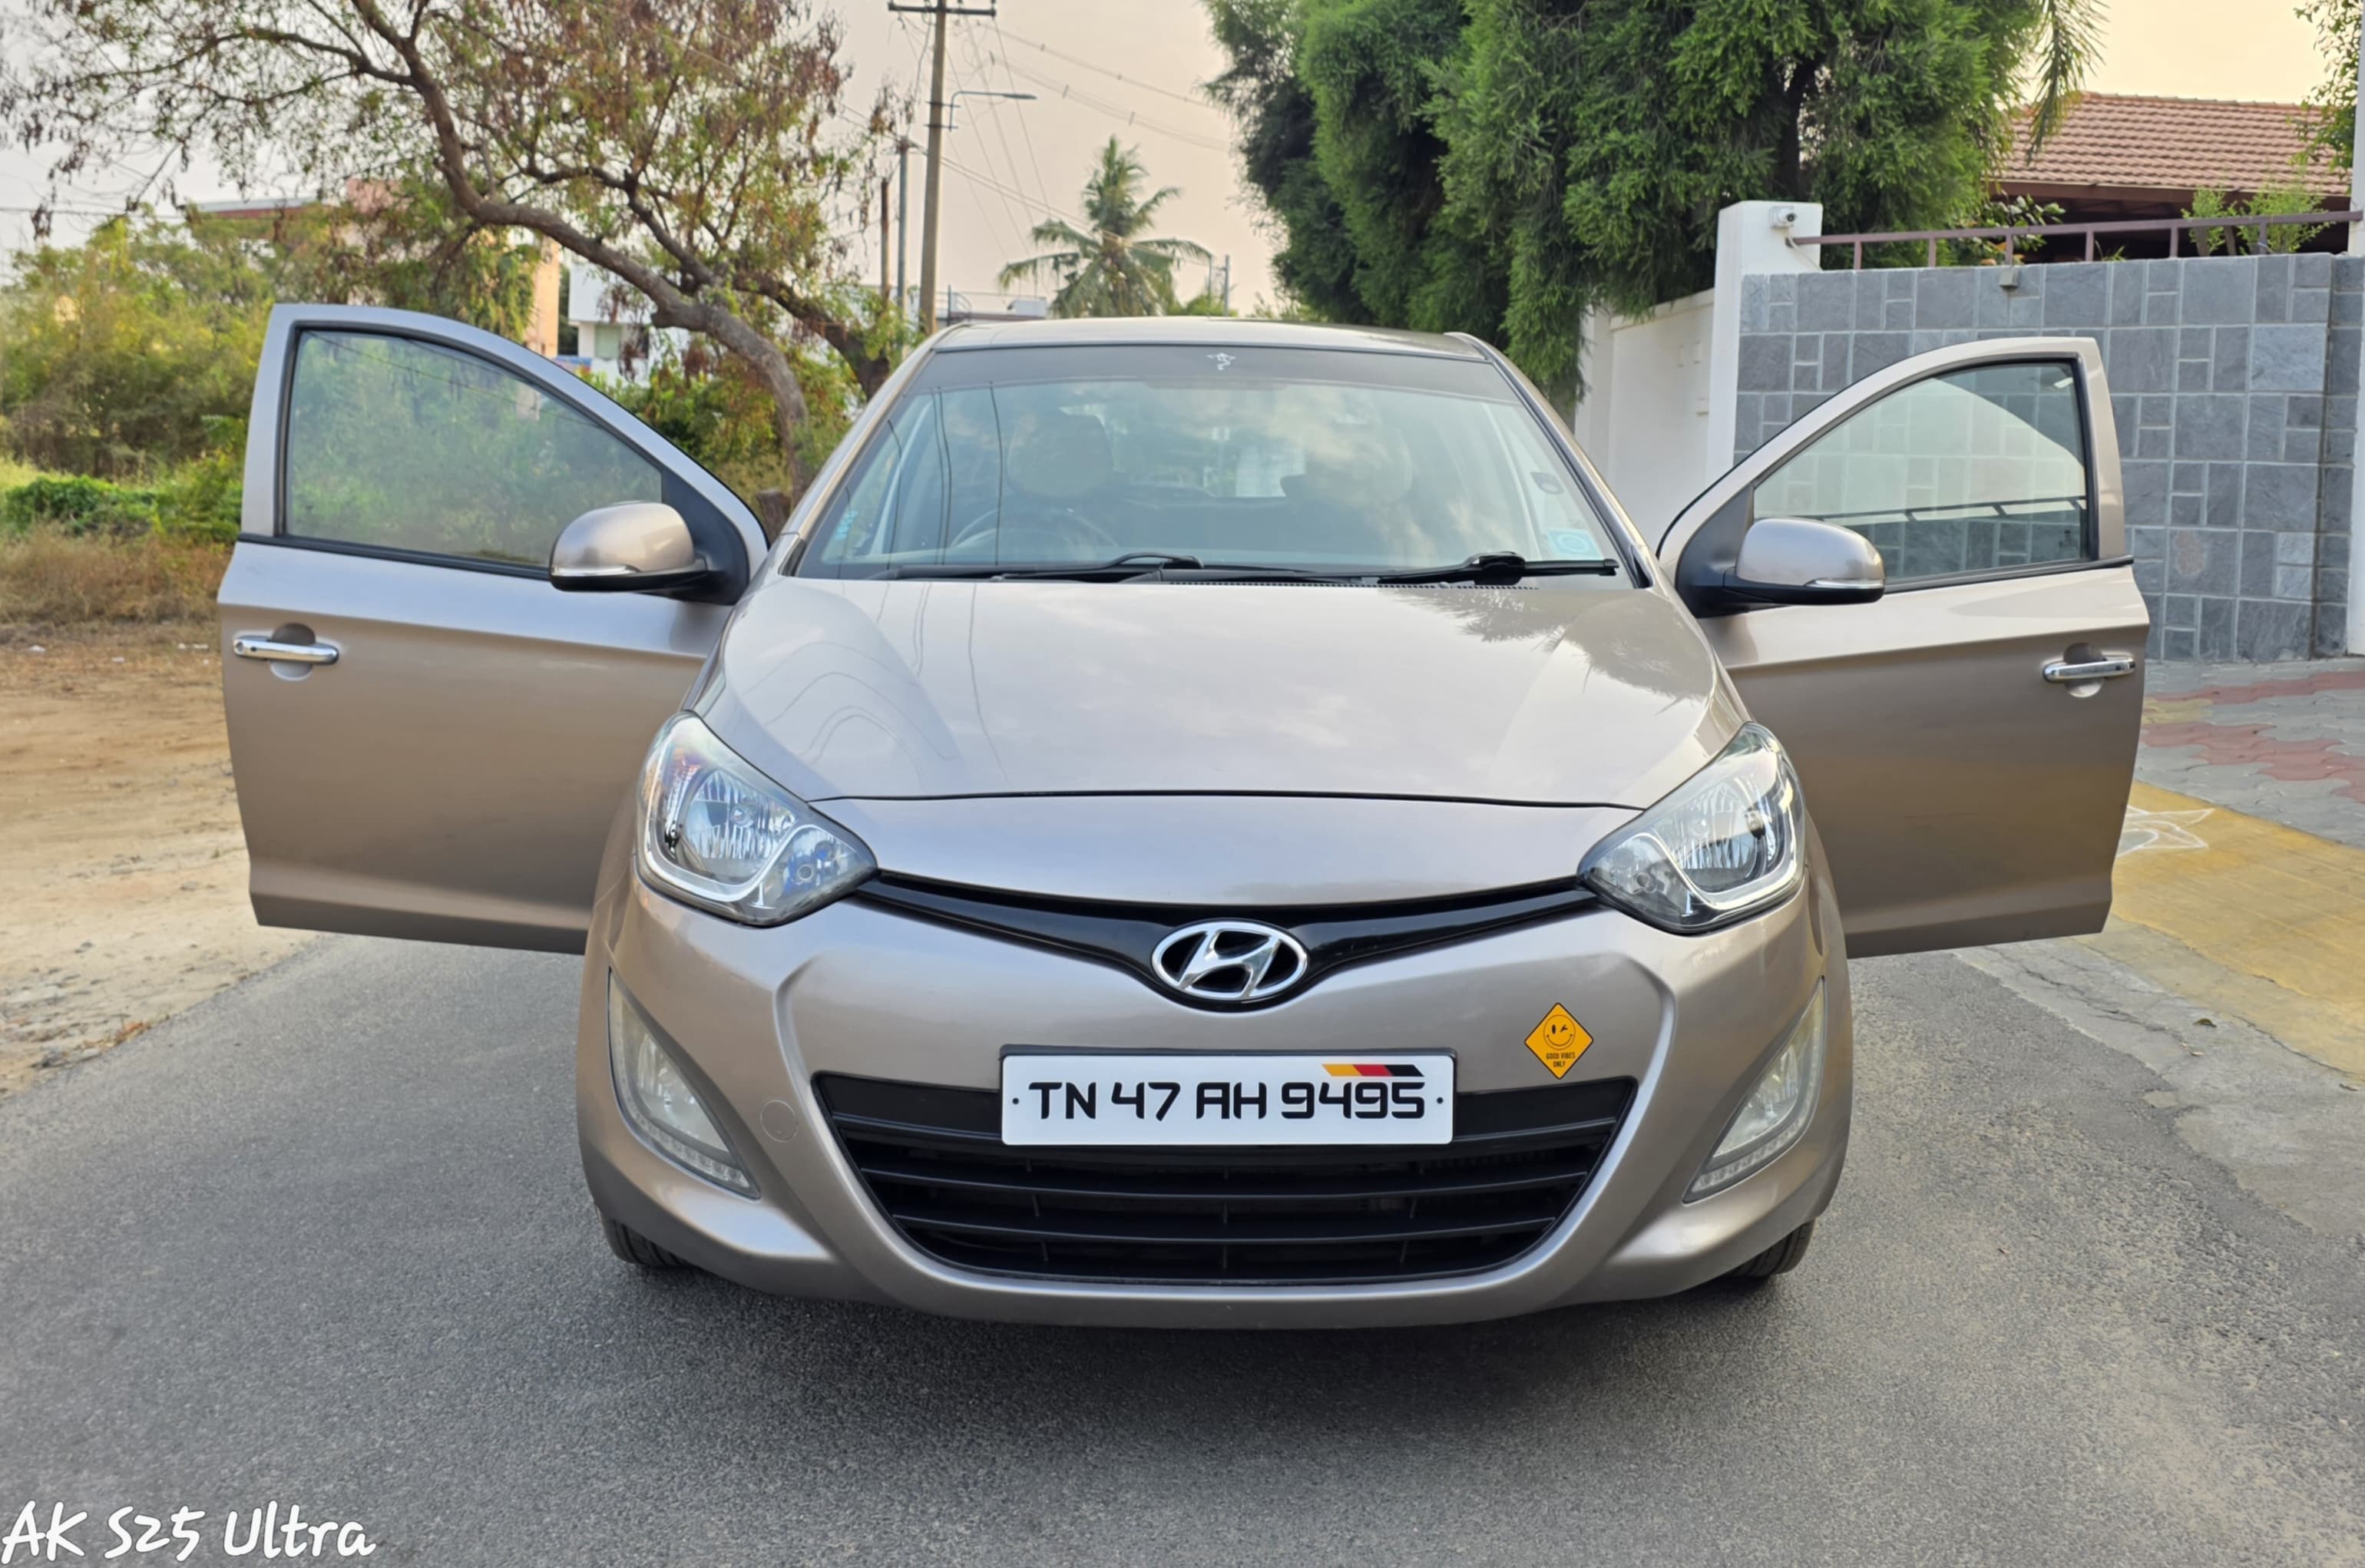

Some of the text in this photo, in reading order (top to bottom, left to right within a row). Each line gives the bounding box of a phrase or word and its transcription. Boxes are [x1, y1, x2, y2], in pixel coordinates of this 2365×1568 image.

[1560, 1051, 1576, 1060] VIBES
[1028, 1081, 1425, 1121] TN 47 AH 9495
